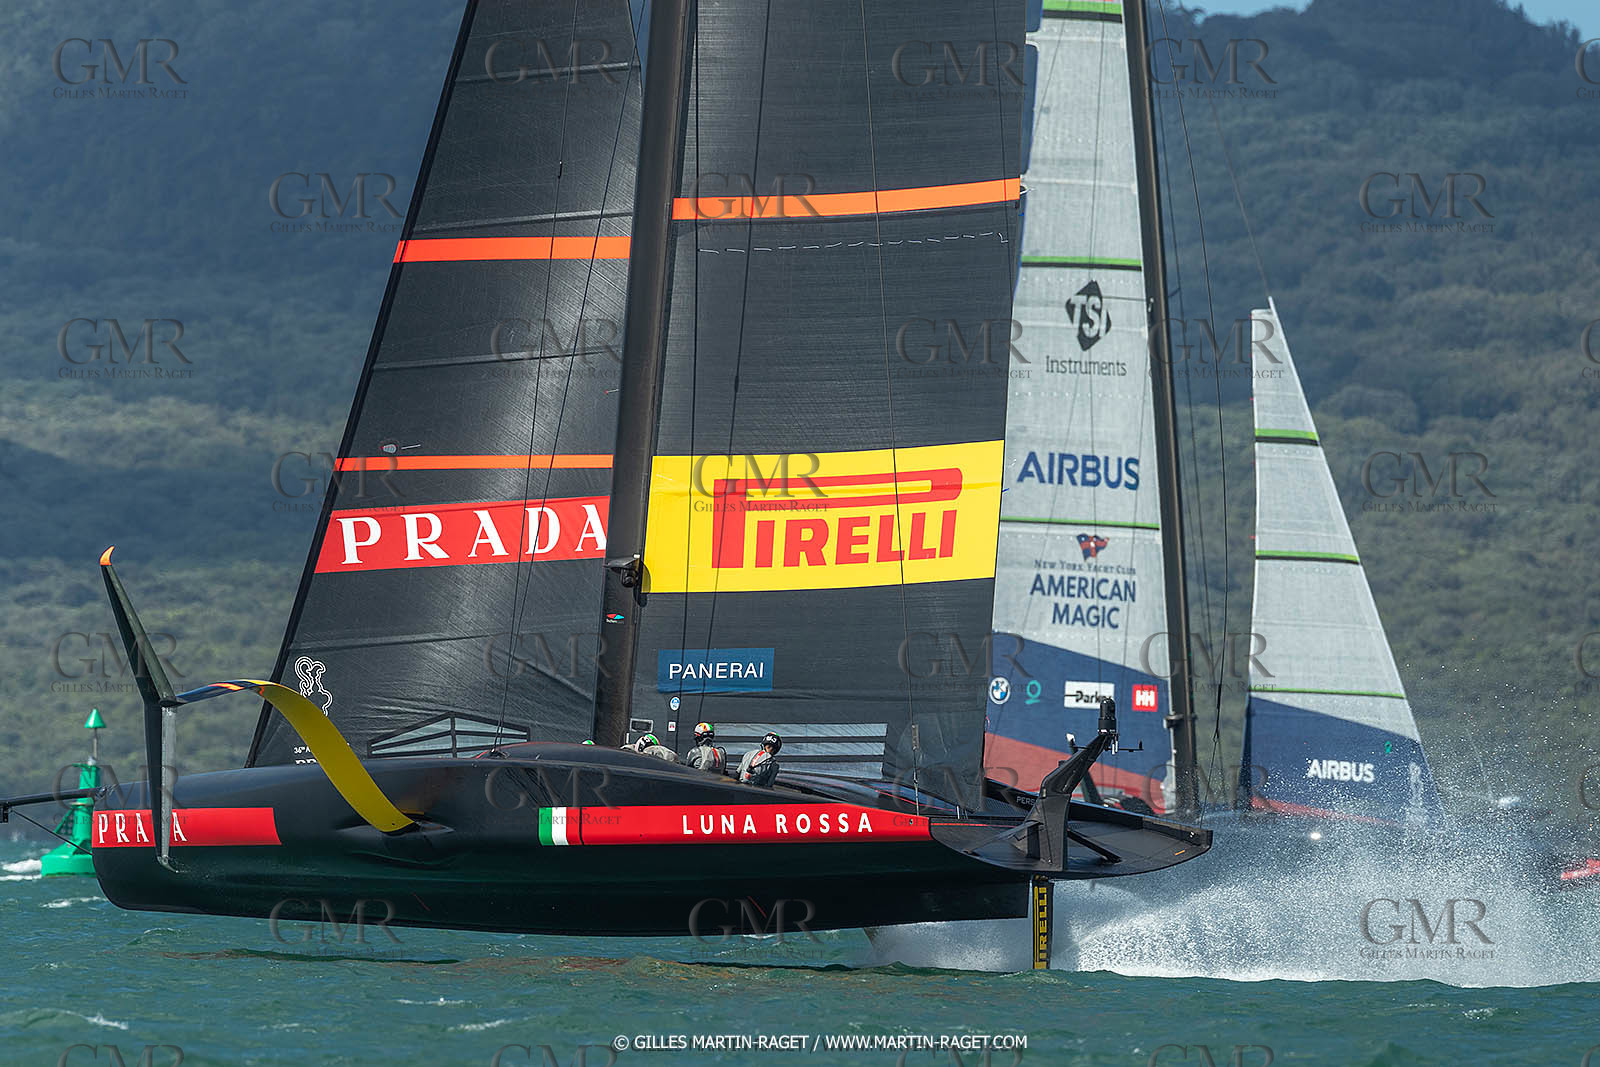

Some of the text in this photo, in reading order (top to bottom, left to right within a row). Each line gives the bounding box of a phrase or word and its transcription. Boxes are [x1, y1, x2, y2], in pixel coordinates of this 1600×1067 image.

[1046, 355, 1127, 376] Instruments
[1016, 451, 1139, 490] AIRBUS
[712, 467, 963, 569] PIRELLI
[336, 504, 607, 564] PRADA
[1030, 573, 1136, 602] AMERICAN
[1052, 602, 1120, 629] MAGIC
[669, 662, 764, 680] PANERAI
[1307, 759, 1375, 783] AIRBUS
[1016, 796, 1036, 806] PERS
[98, 812, 188, 844] PRAA
[682, 813, 873, 835] LUNA ROSSA
[1034, 886, 1047, 969] PIRELLI
